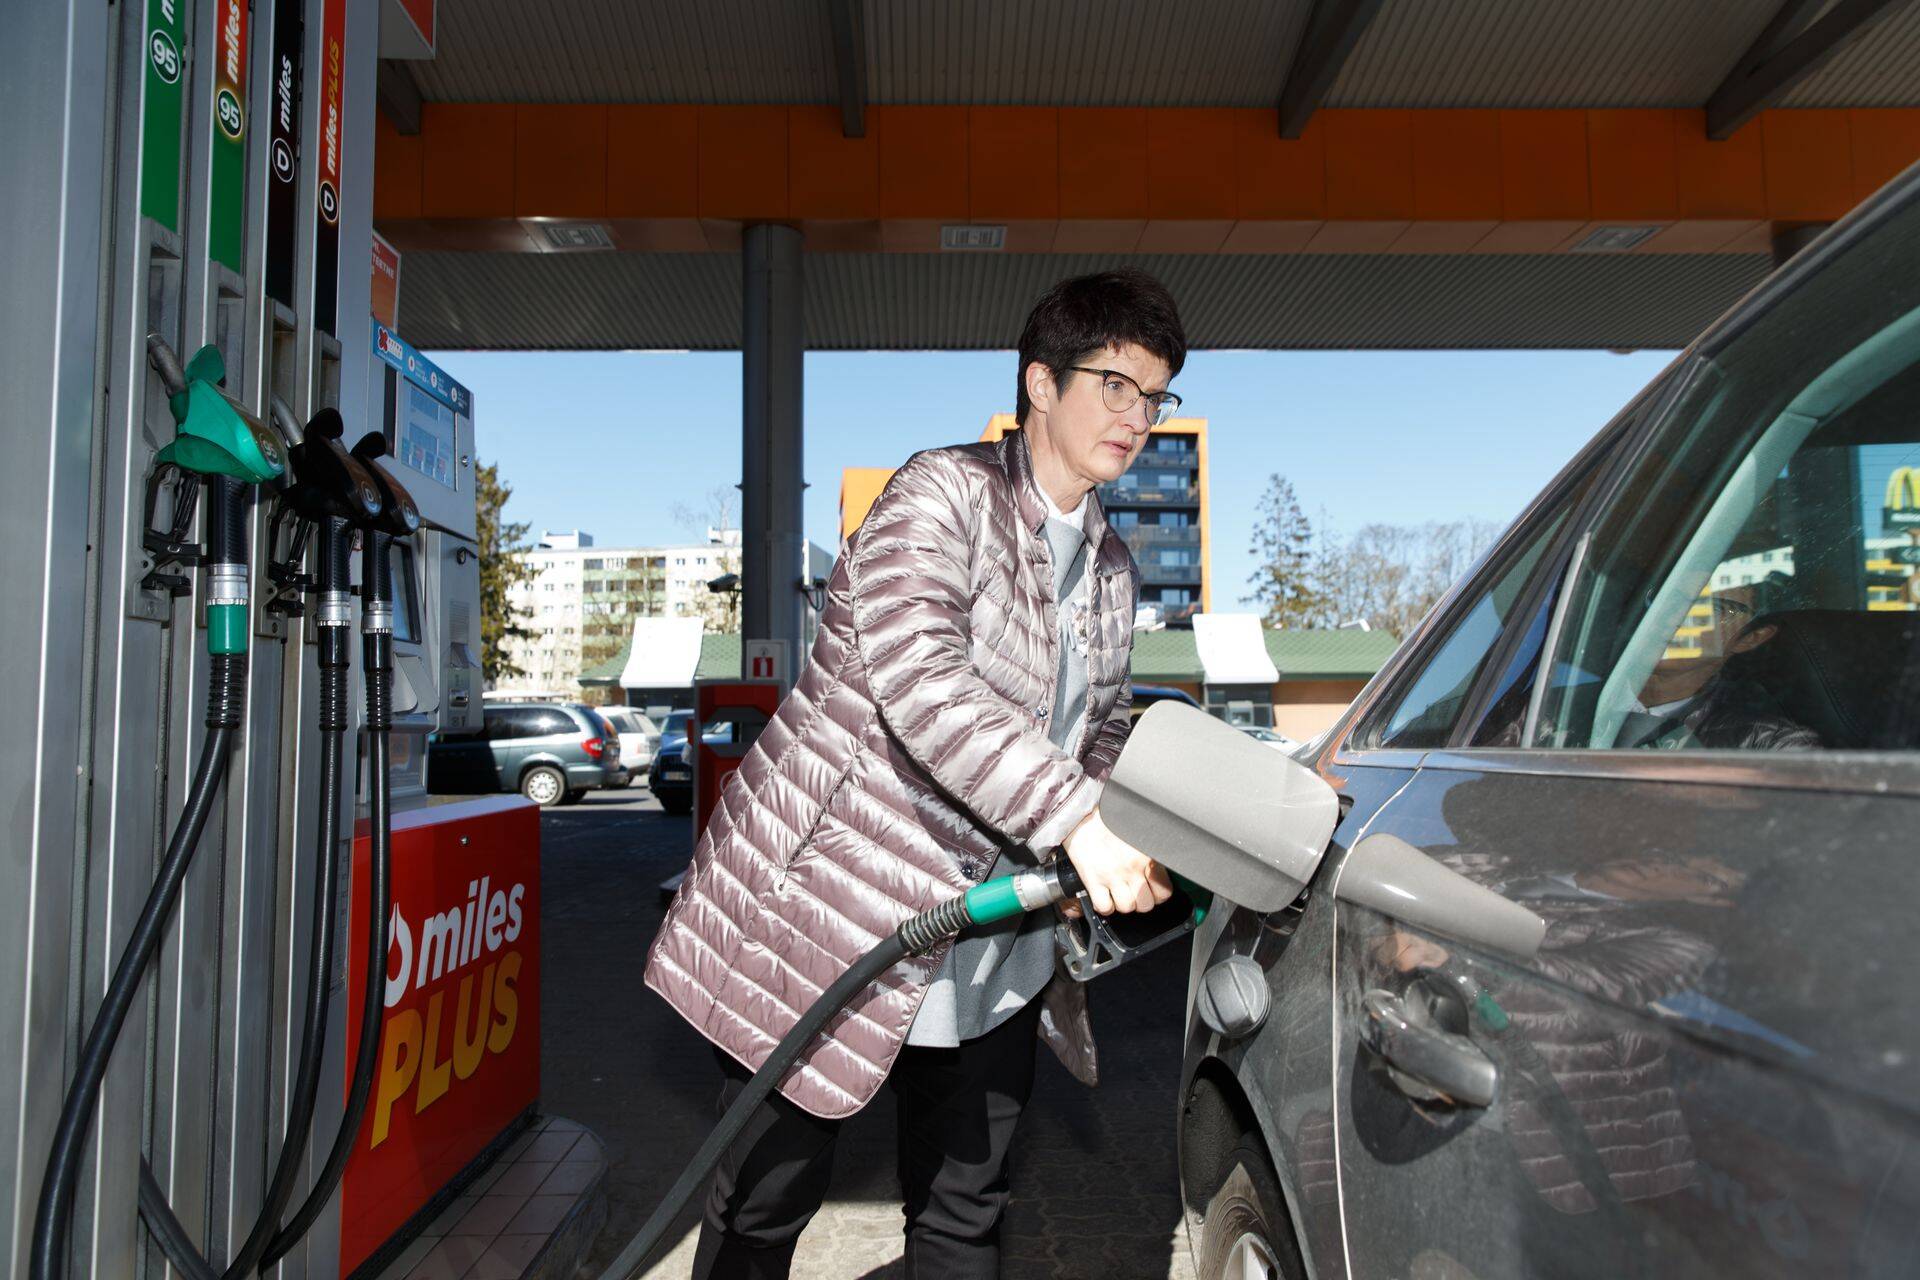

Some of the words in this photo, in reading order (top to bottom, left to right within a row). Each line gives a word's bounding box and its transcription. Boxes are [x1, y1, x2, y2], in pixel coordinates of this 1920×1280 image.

[154, 39, 176, 75] 95
[225, 0, 240, 84] miles
[220, 97, 240, 129] 95
[279, 54, 292, 132] miles
[278, 147, 289, 171] D
[324, 189, 334, 212] D
[416, 876, 525, 989] miles
[371, 951, 522, 1150] PLUS
